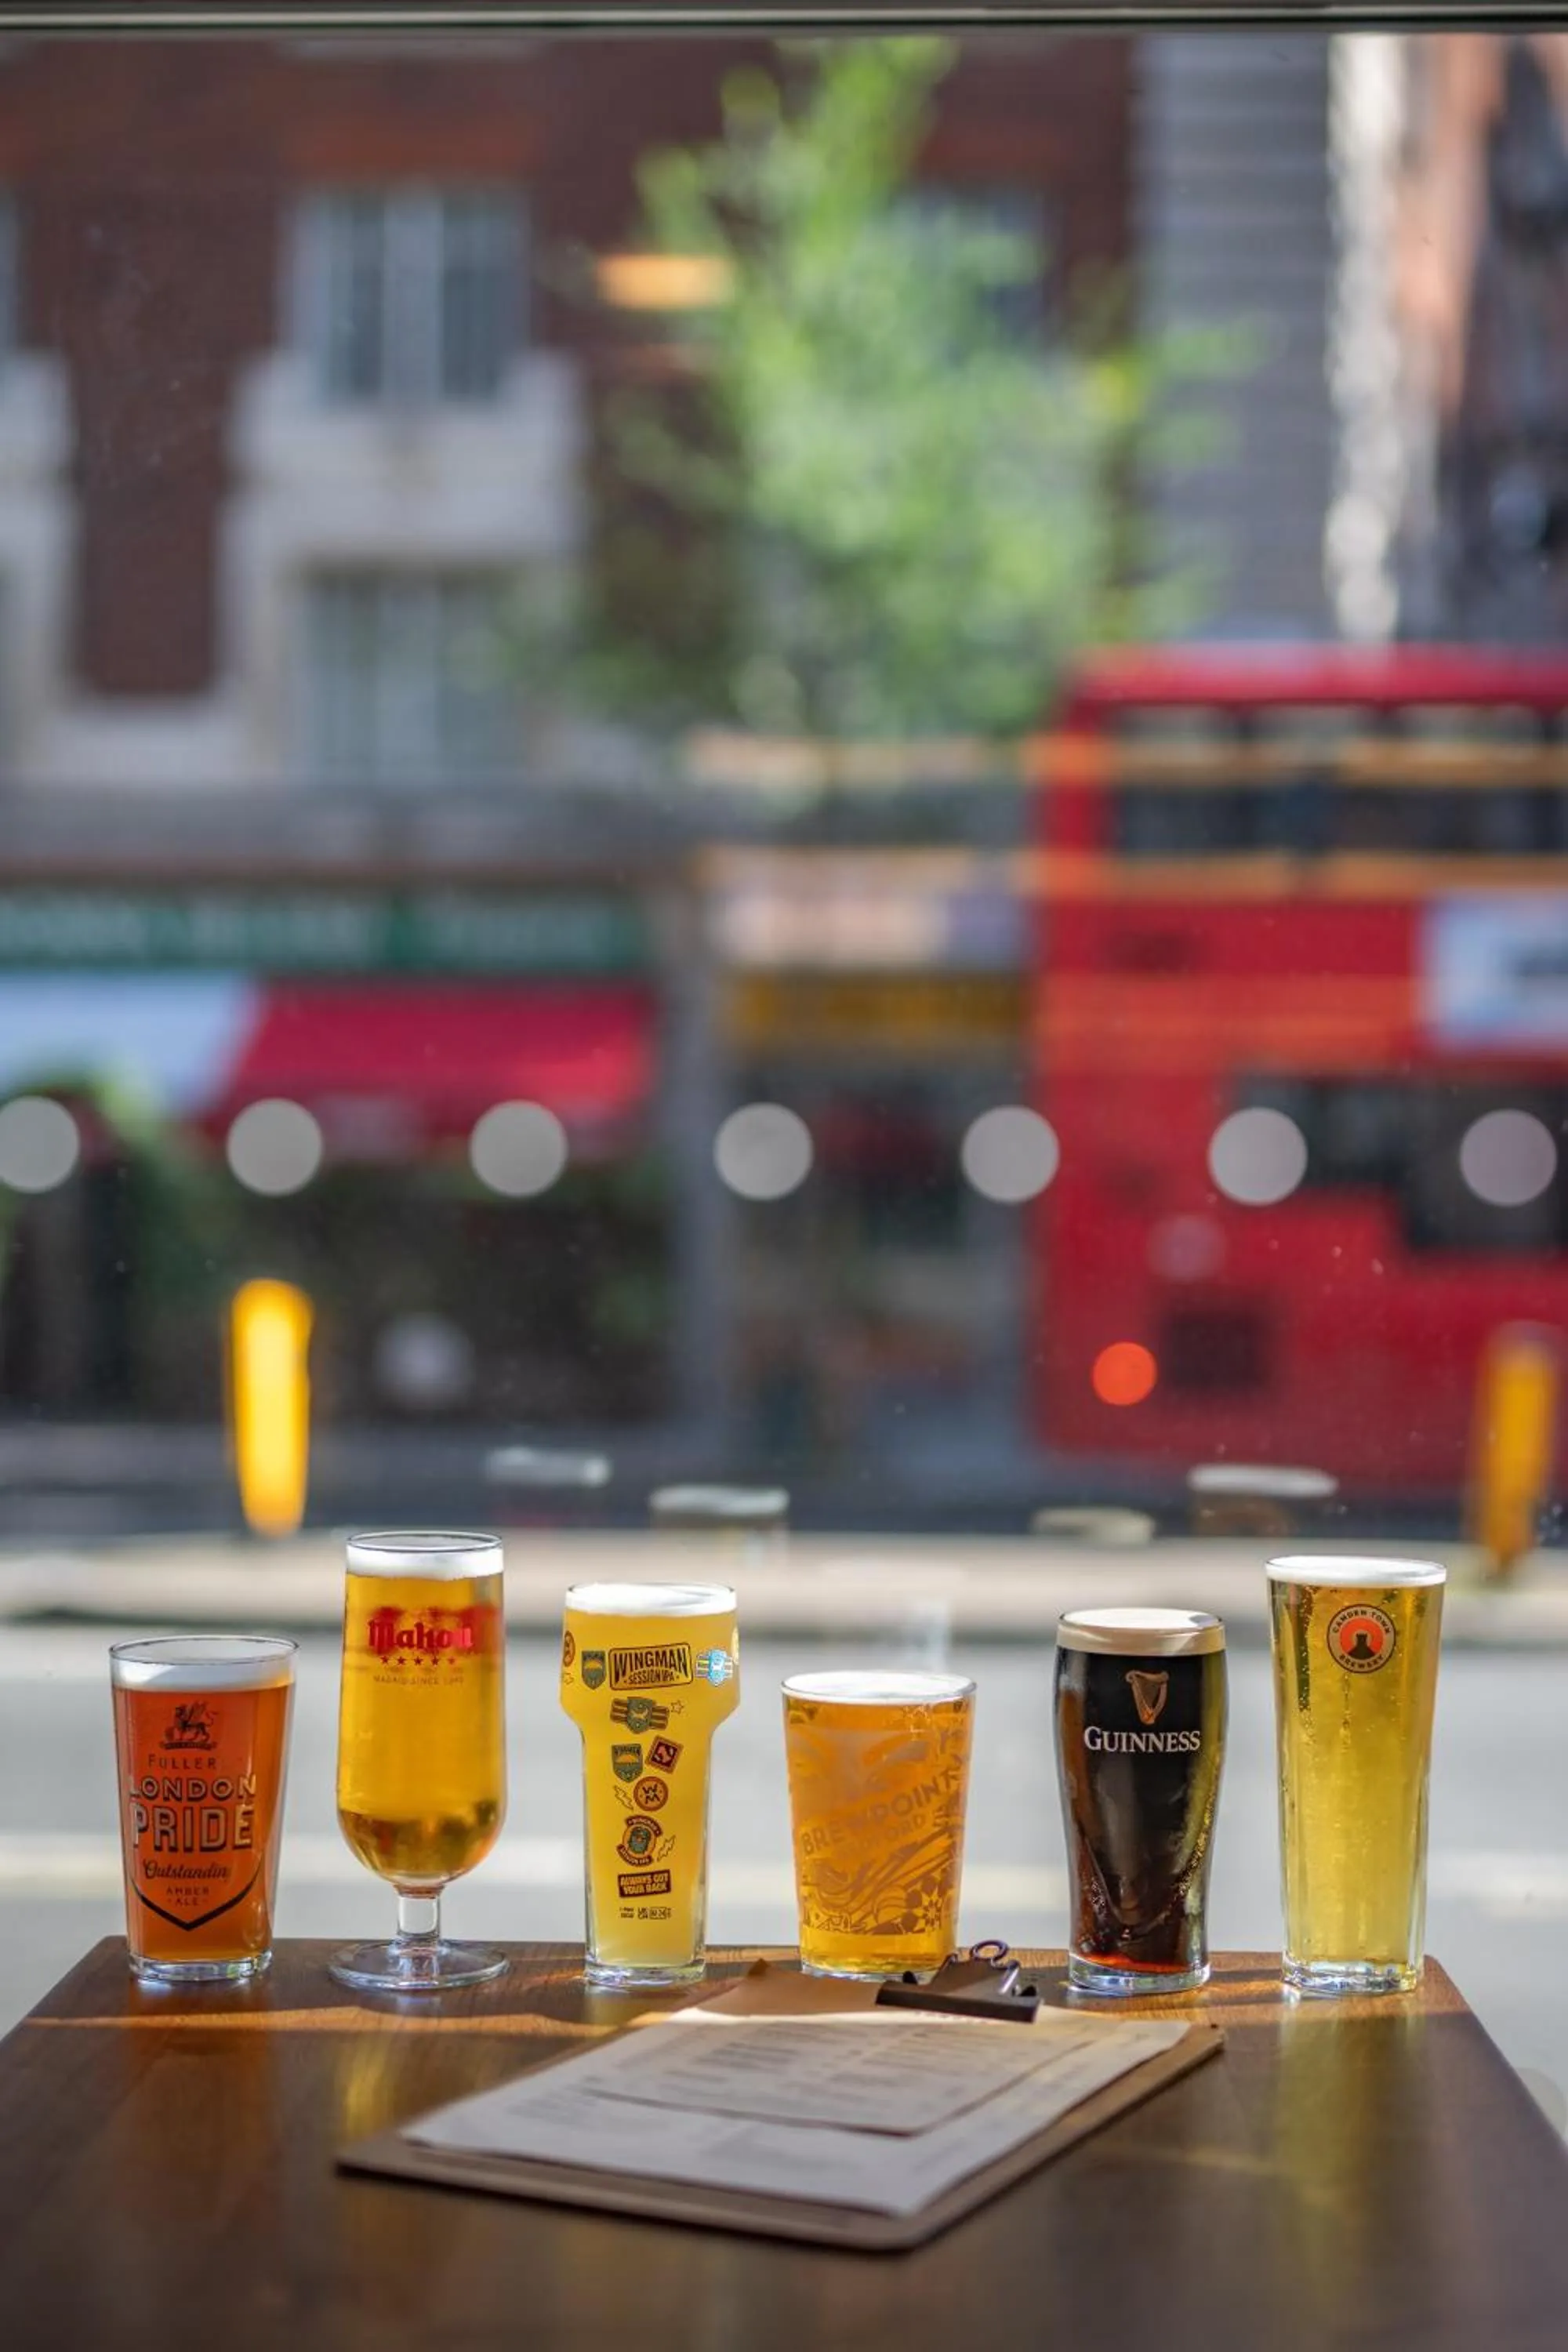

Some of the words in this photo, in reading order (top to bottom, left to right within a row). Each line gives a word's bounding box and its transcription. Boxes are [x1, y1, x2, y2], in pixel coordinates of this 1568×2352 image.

[614, 1647, 688, 1685] WINGMAN
[628, 1670, 661, 1684] SESSION
[1083, 1726, 1201, 1753] GUINNESS
[129, 1773, 257, 1802] LONDON
[801, 1769, 961, 1856] BREPOINT
[130, 1803, 255, 1853] PRIDE
[165, 1886, 210, 1896] AMBER
[175, 1897, 200, 1907] ALE
